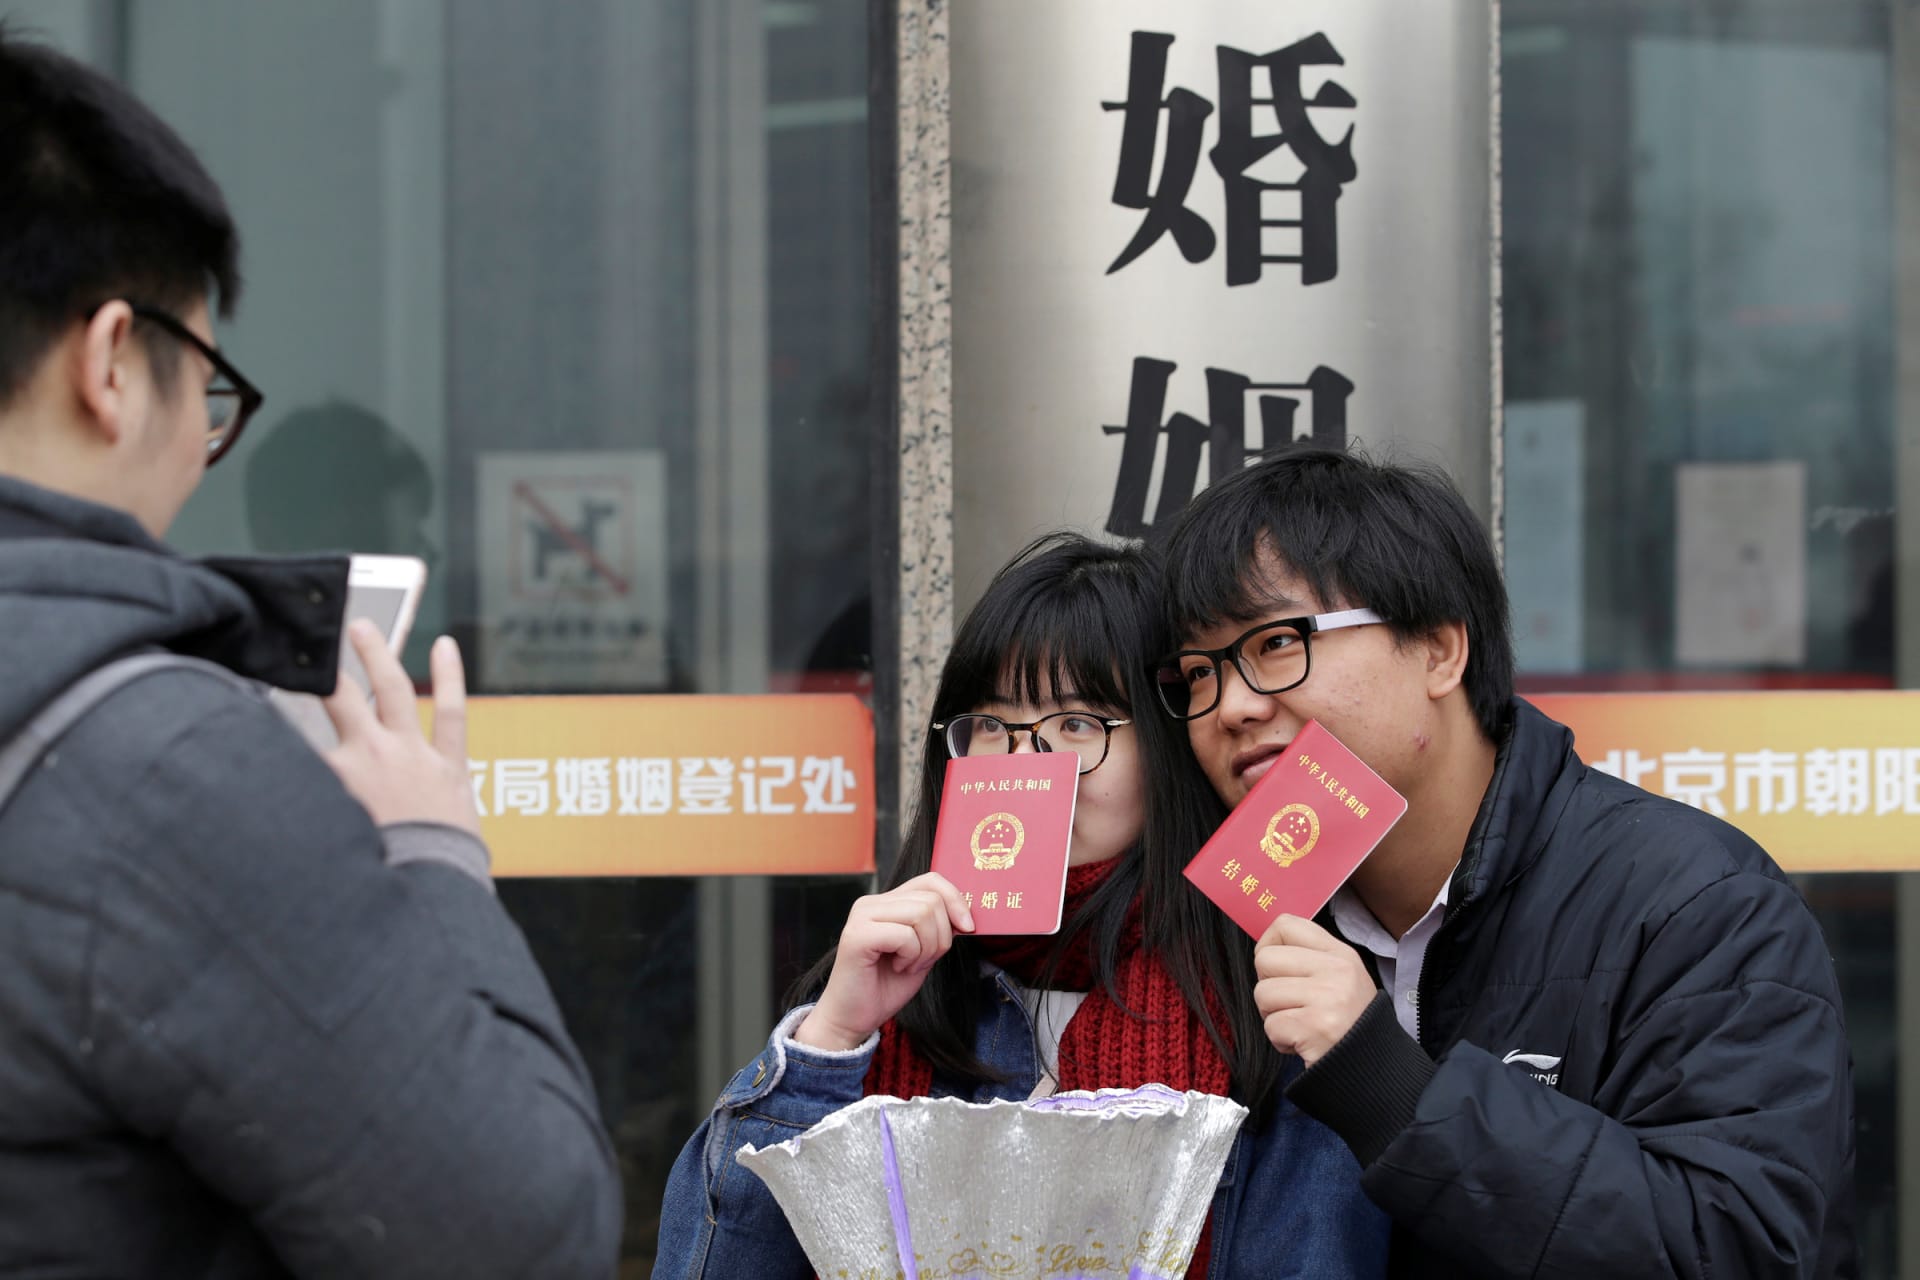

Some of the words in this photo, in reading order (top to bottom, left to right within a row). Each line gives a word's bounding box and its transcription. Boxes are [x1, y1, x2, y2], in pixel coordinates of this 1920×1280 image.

[961, 779, 1051, 794] 中华人民共和国
[1299, 754, 1370, 819] 中华人民共和国
[1221, 858, 1277, 912] 结婚证
